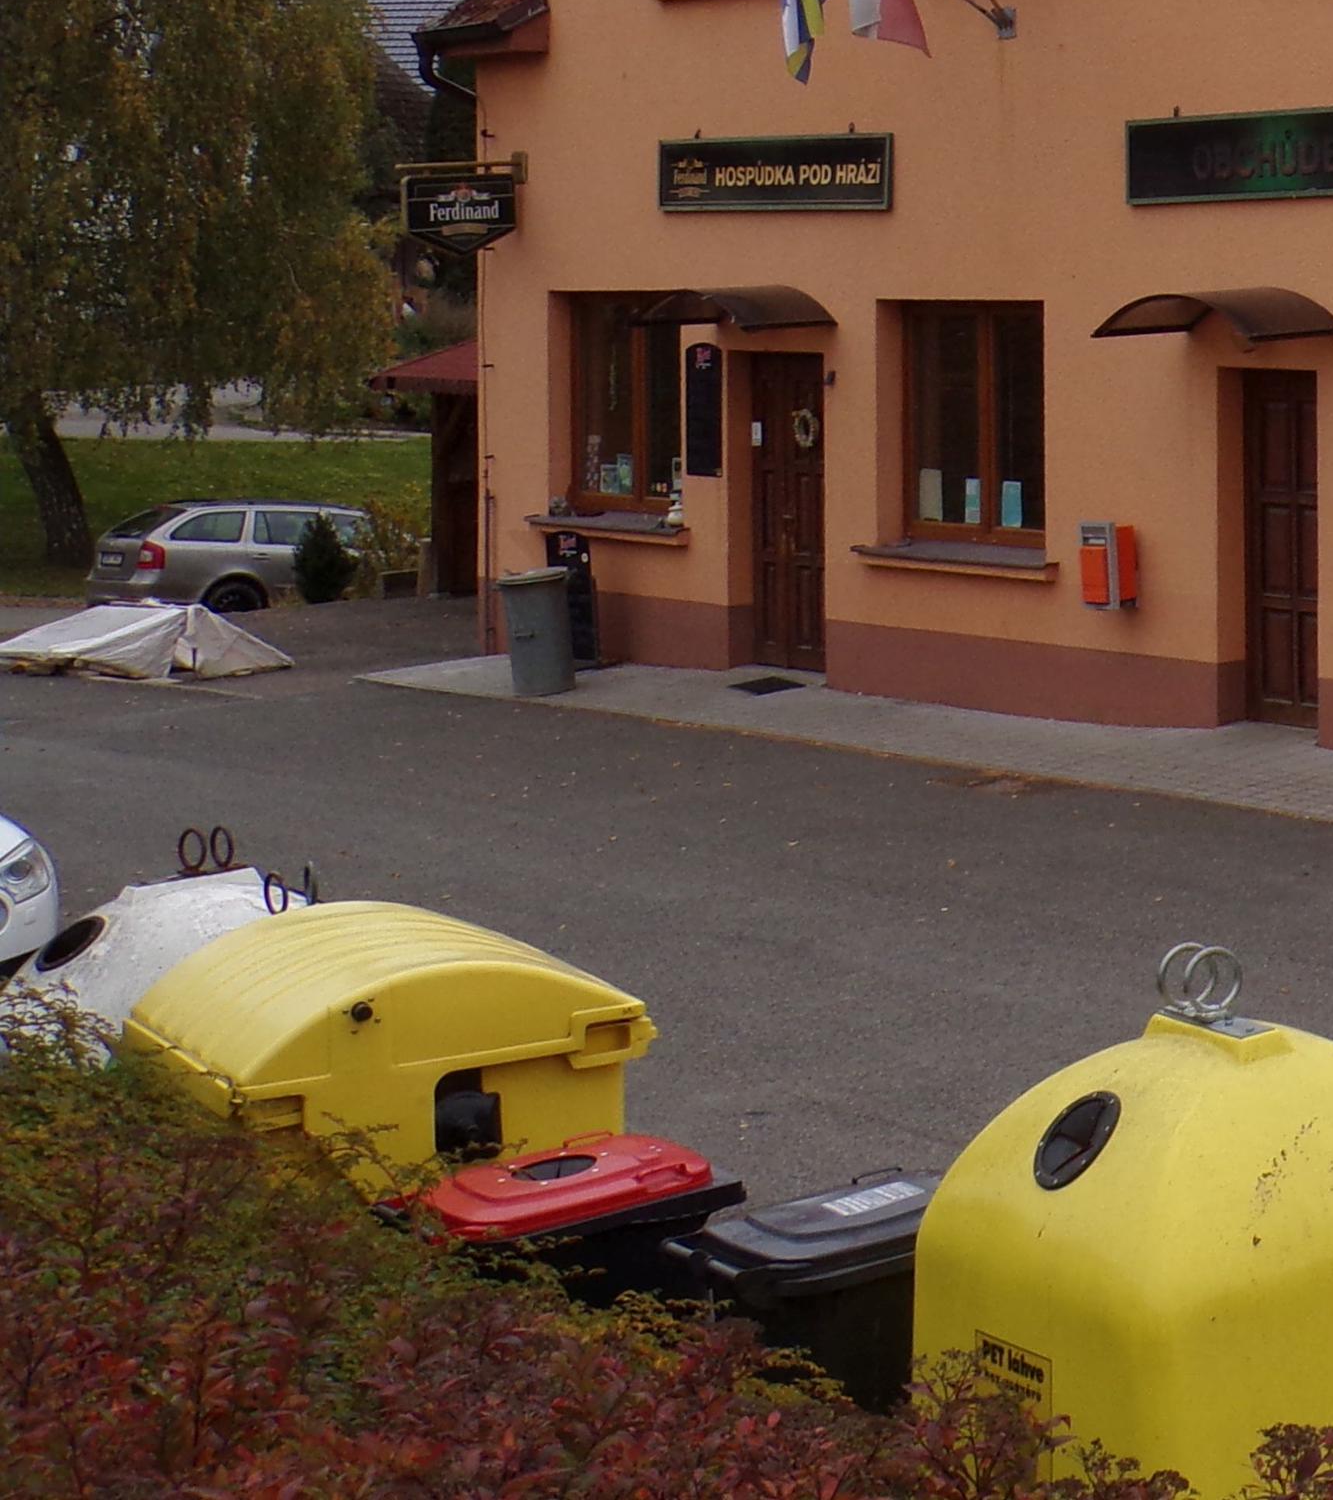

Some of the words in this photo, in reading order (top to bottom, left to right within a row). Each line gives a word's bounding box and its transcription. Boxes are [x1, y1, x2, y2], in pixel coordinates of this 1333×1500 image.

[799, 163, 832, 186] POD
[836, 157, 881, 185] HRÁZÍ
[429, 200, 500, 222] Ferdinand
[982, 1338, 1004, 1368] PET
[1008, 1348, 1044, 1384] láhve
